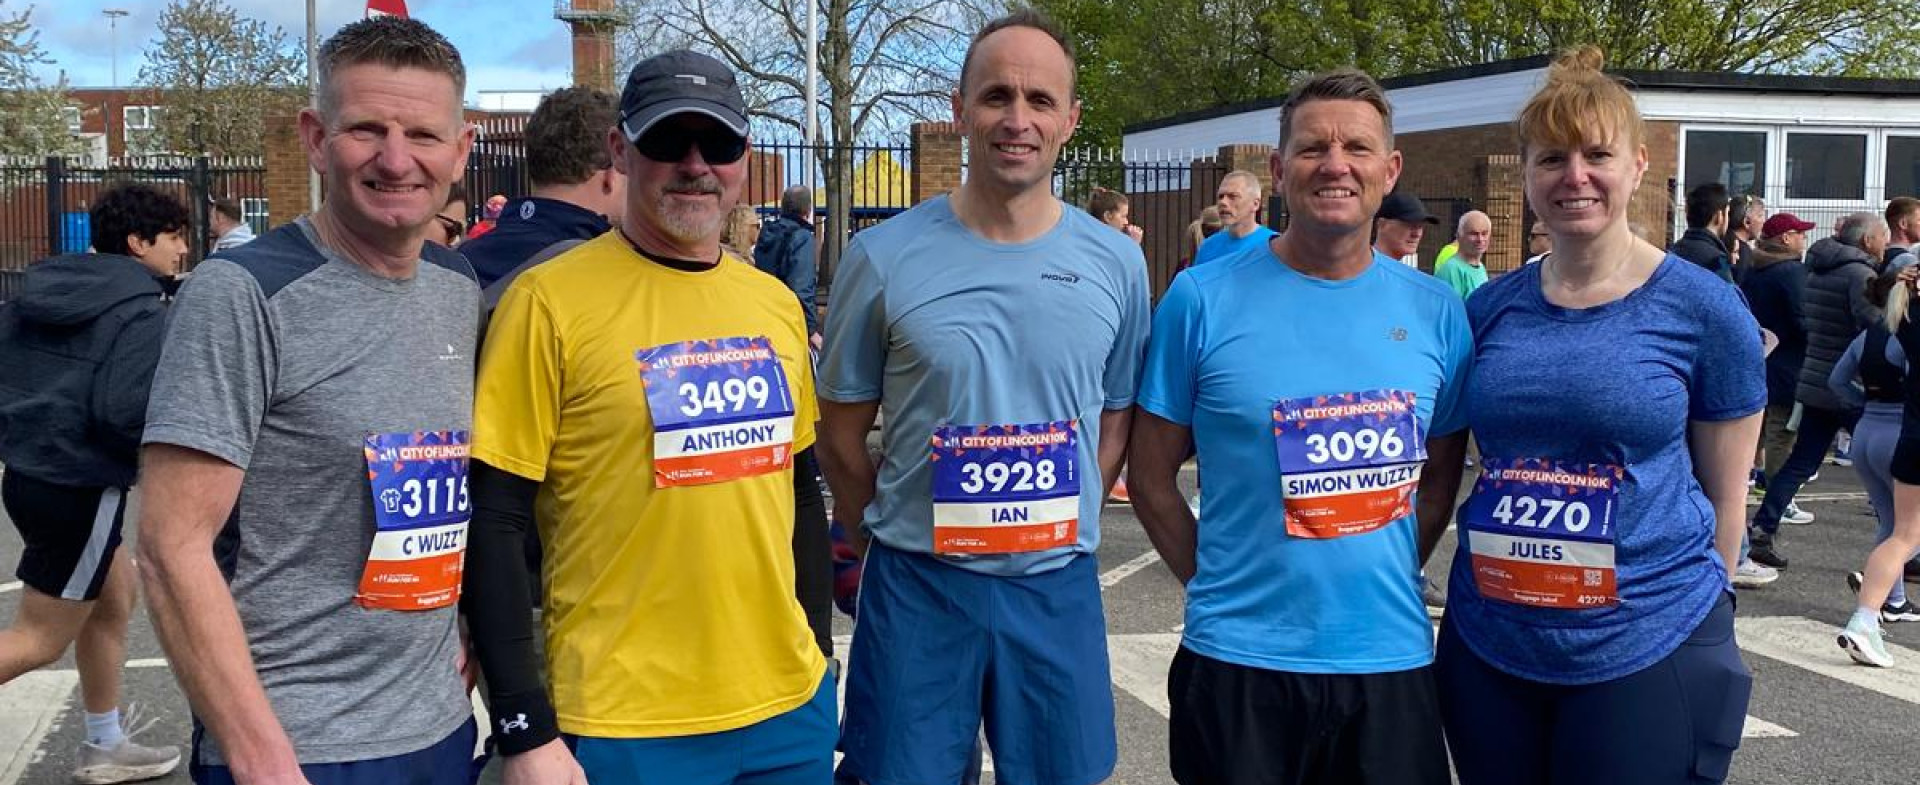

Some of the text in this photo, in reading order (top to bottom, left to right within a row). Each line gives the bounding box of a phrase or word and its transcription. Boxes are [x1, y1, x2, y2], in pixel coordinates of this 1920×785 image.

[679, 375, 769, 417] 3499
[682, 424, 775, 452] ANTHONY
[1306, 427, 1404, 464] 3096
[960, 459, 1056, 494] 3928
[1288, 465, 1418, 496] SIMON WUZZY
[402, 475, 469, 518] 3115
[991, 506, 1028, 523] IAN
[1492, 495, 1591, 533] 4270
[402, 535, 413, 556] C
[1508, 541, 1563, 561] JULES
[1577, 594, 1606, 605] 4270
